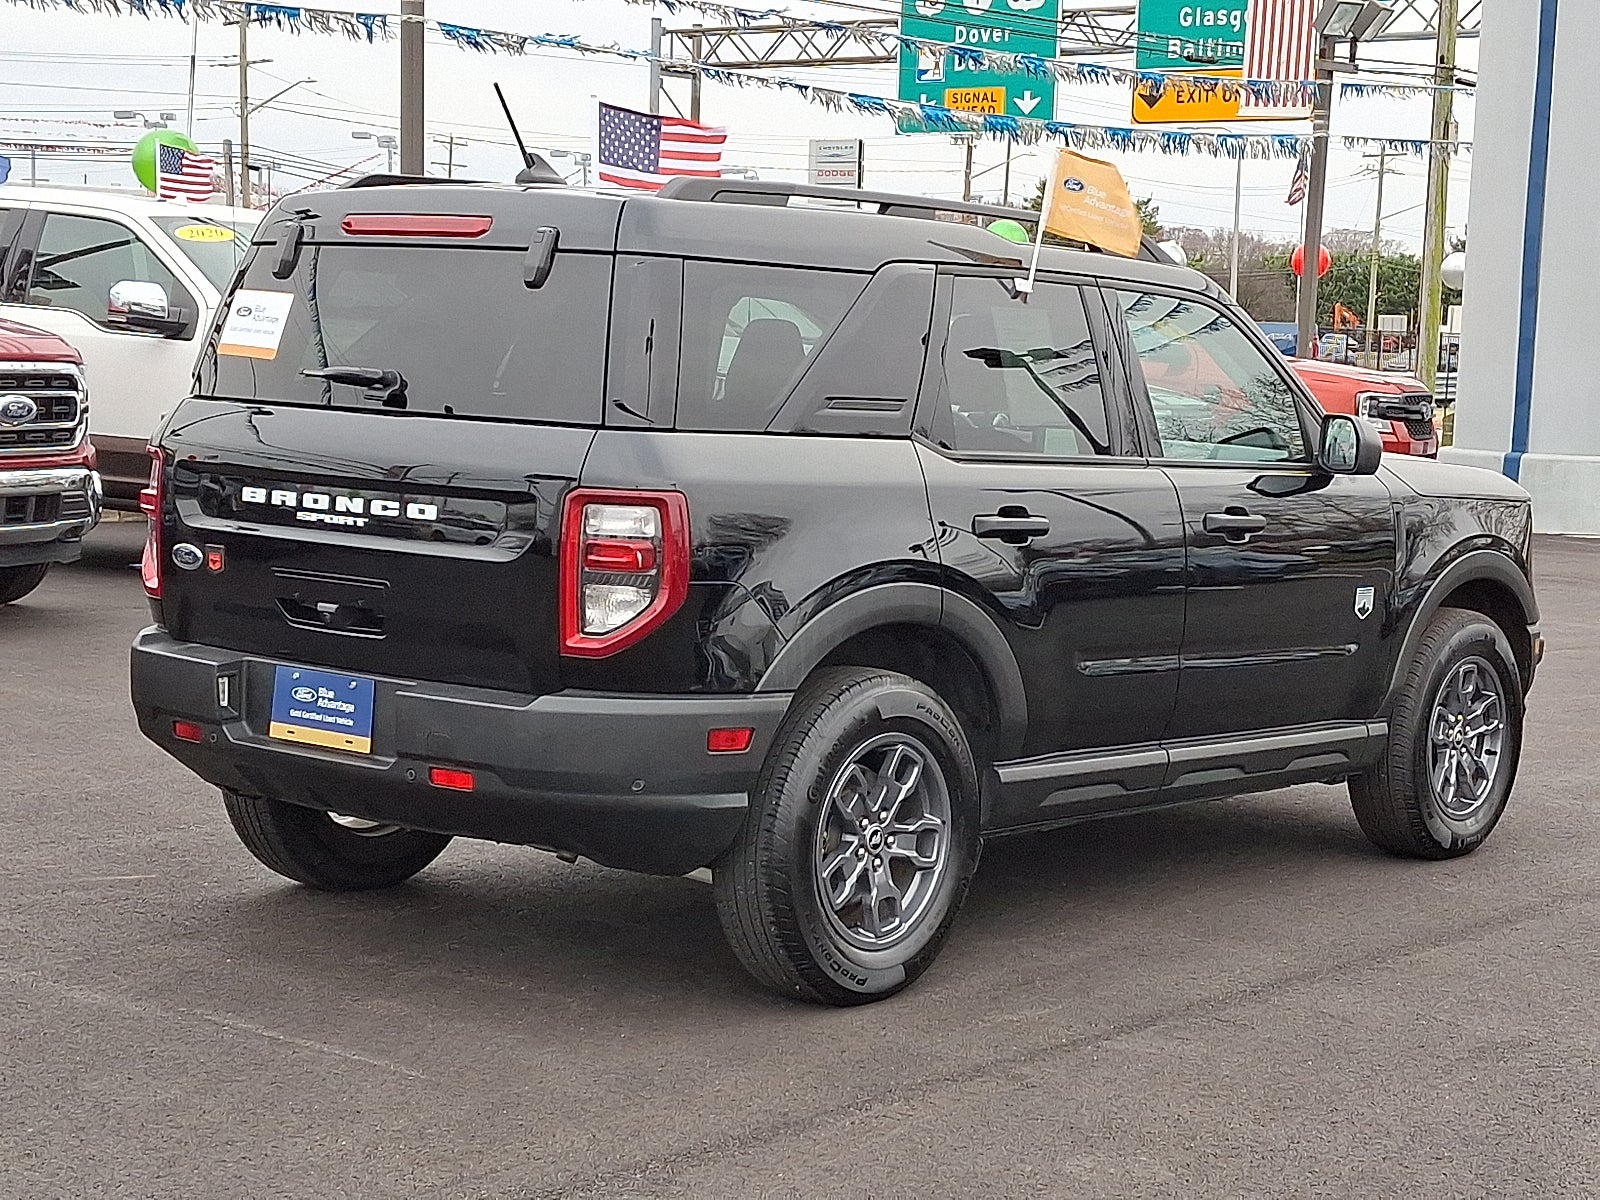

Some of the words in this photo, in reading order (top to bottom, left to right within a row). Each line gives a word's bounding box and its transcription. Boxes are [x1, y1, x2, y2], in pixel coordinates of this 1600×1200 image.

[1179, 6, 1247, 32] Glasg
[954, 26, 1013, 44] Dover
[951, 91, 998, 104] SIGNAL
[1175, 87, 1215, 104] EXIT
[817, 169, 854, 177] DODGE
[1086, 185, 1106, 198] Blue
[189, 228, 224, 239] 2020
[7, 402, 29, 416] Ford
[241, 486, 439, 521] BRONCO
[296, 511, 370, 528] SPORT
